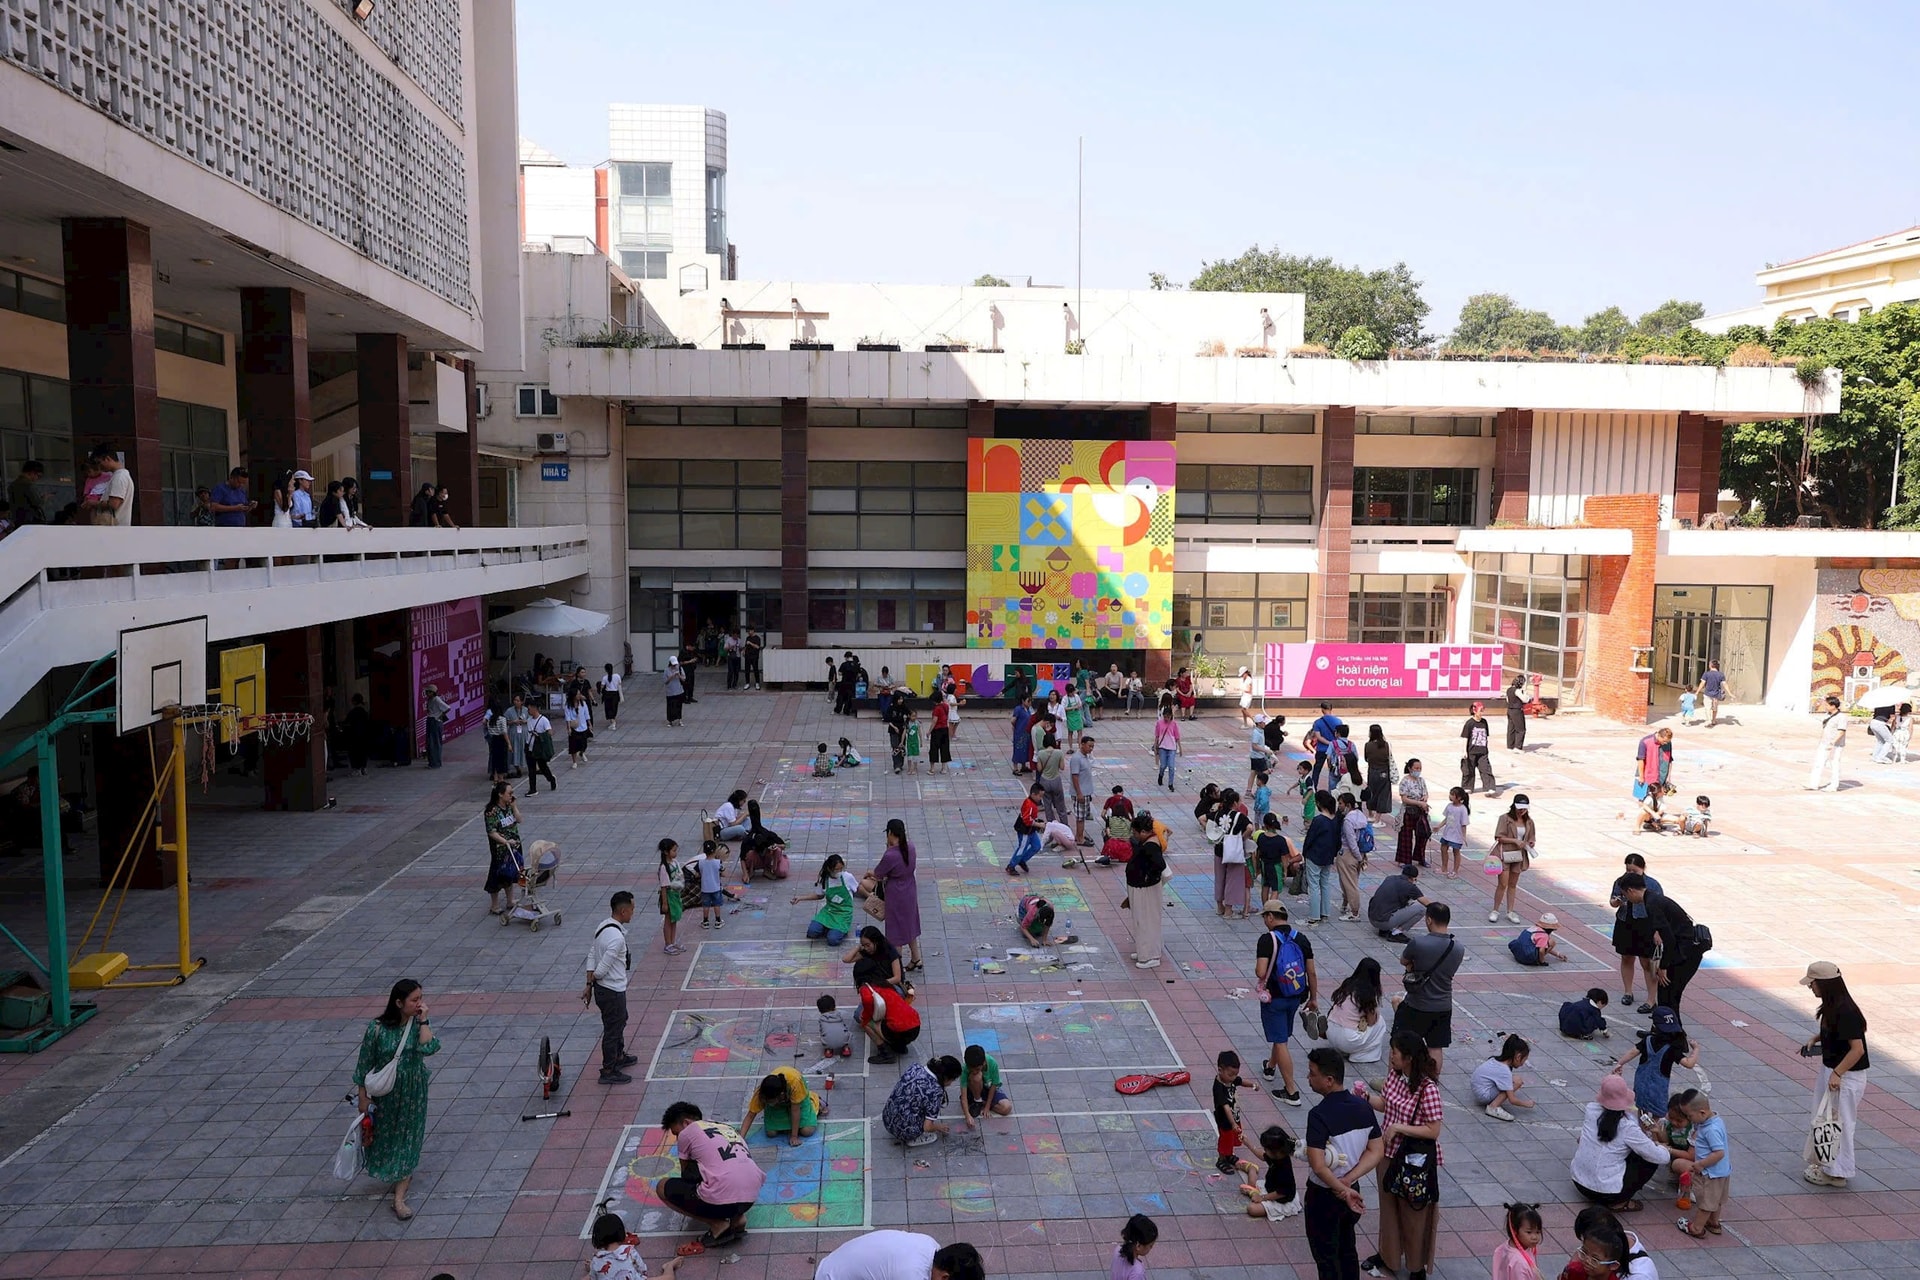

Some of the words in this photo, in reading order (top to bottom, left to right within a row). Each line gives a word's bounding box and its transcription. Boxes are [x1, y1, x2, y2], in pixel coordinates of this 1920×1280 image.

[561, 468, 567, 477] C
[1336, 664, 1361, 675] Hoài
[1363, 664, 1389, 676] niệm
[1335, 677, 1356, 687] cho
[1357, 677, 1388, 689] tương
[1389, 677, 1403, 687] lai
